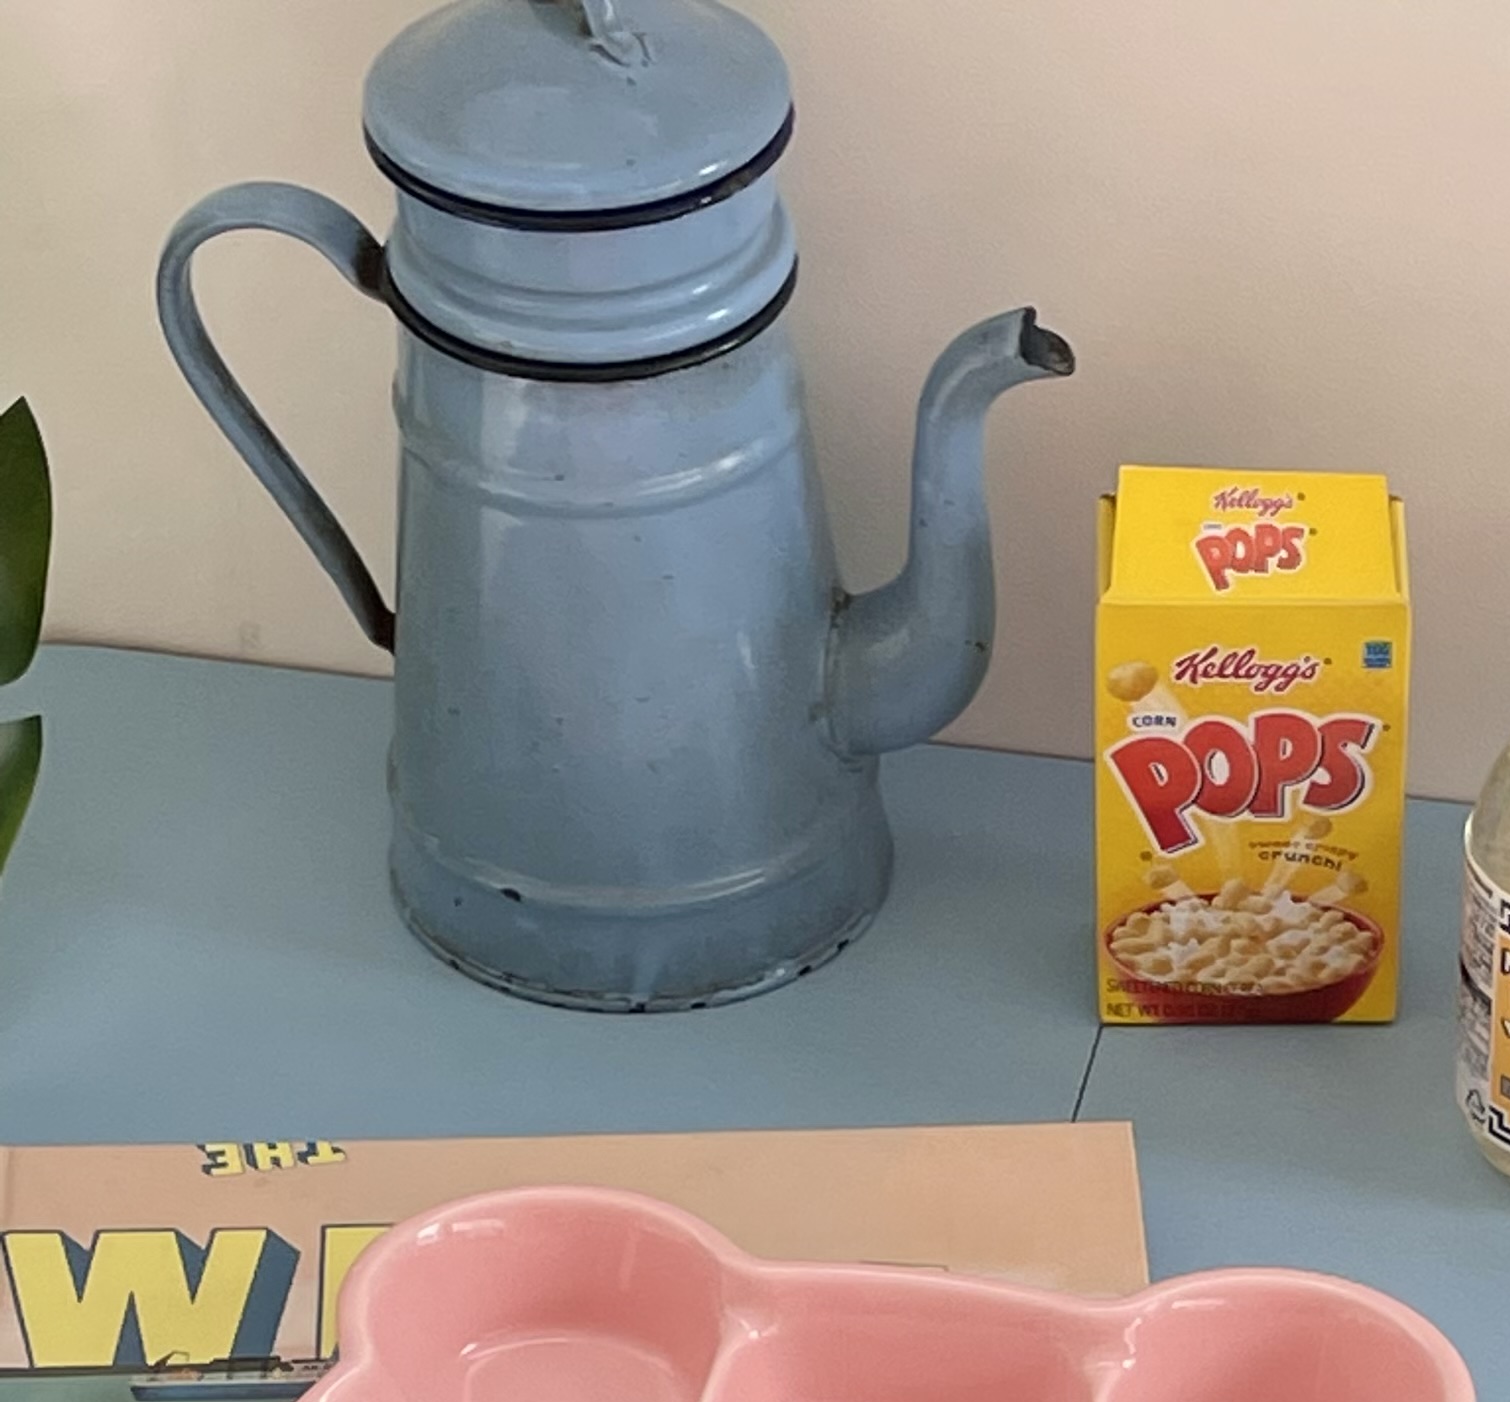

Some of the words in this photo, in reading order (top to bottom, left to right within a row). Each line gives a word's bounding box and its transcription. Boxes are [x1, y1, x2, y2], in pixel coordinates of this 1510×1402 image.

[1213, 485, 1293, 517] Kellogg's
[1195, 523, 1304, 591] POPS
[1173, 646, 1321, 693] Kellogg's
[1131, 714, 1178, 728] CORN
[1108, 711, 1378, 855] POPS
[198, 1140, 347, 1177] THE
